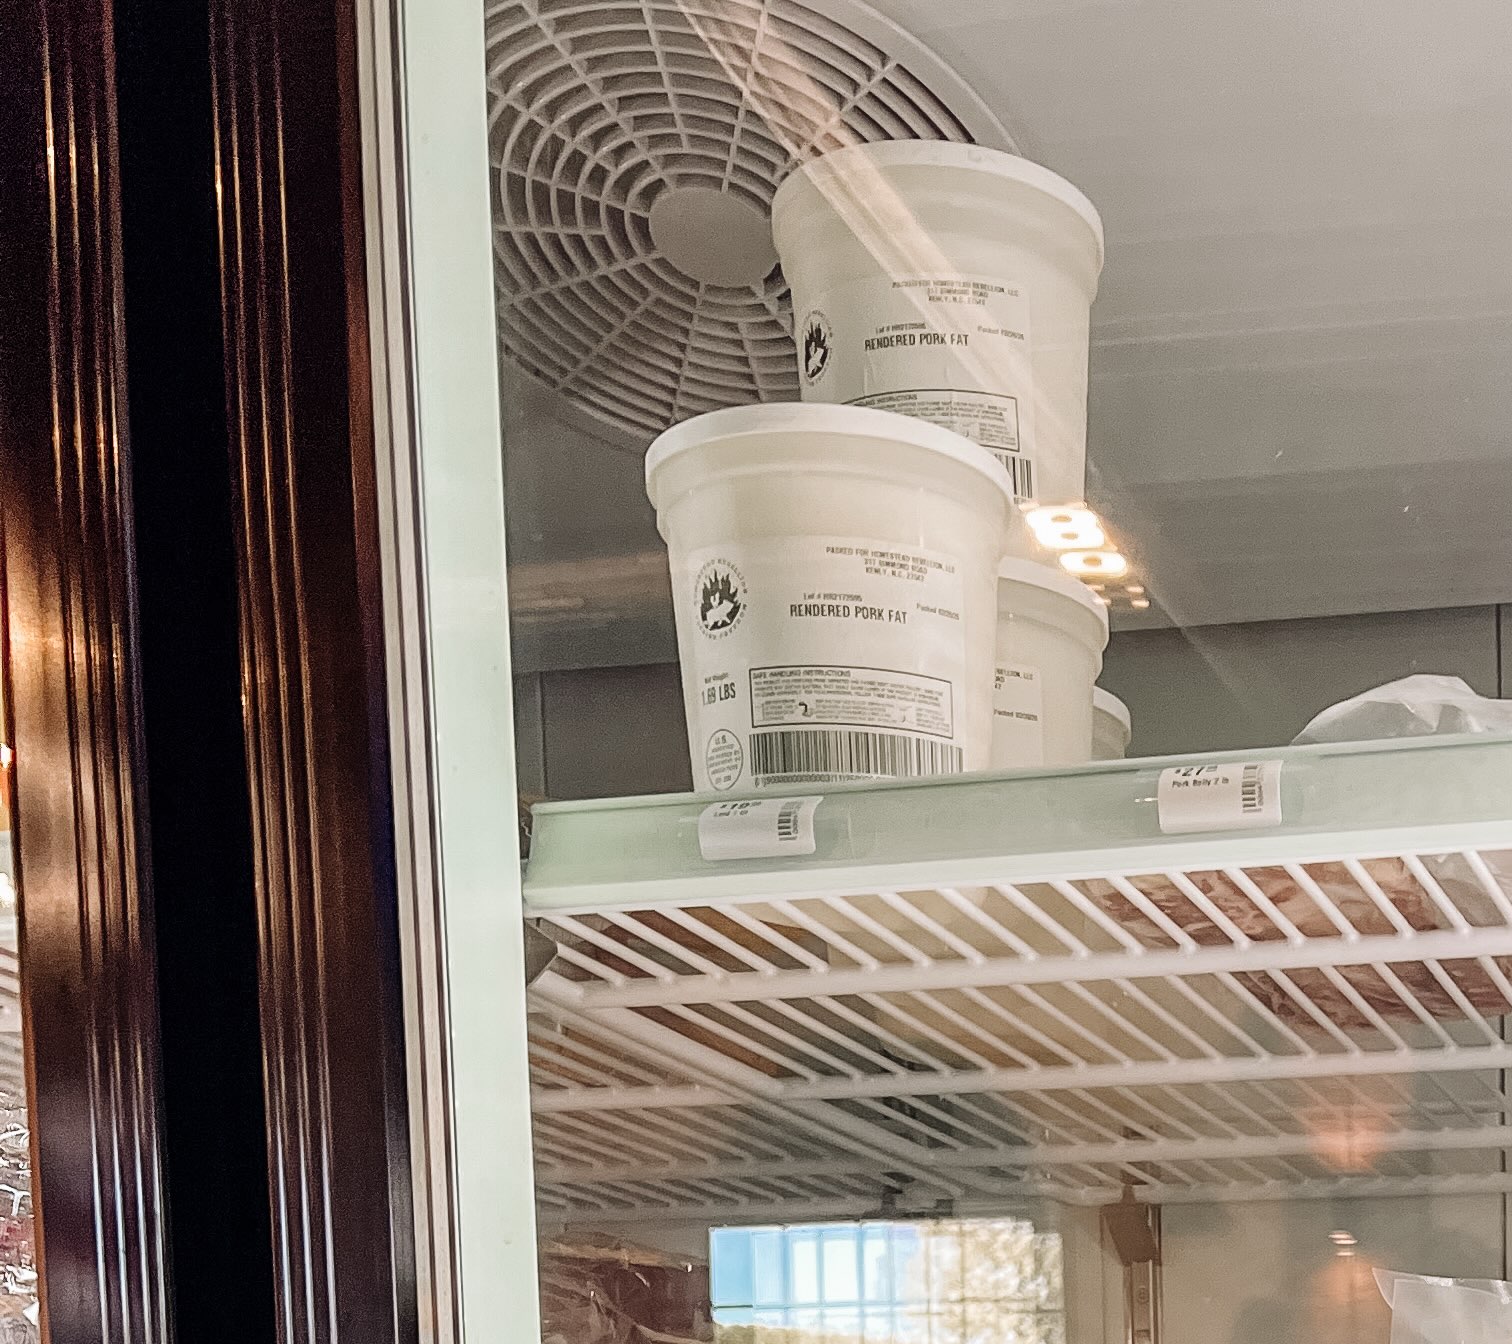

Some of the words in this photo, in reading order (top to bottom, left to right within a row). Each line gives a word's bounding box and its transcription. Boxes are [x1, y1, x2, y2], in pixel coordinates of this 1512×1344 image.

[864, 333, 916, 350] RENDERED
[919, 332, 947, 346] PORK
[950, 334, 969, 346] FAT
[790, 603, 850, 618] RENDERED
[854, 606, 885, 622] PORK
[888, 609, 908, 625] FAT
[718, 681, 736, 702] LBS
